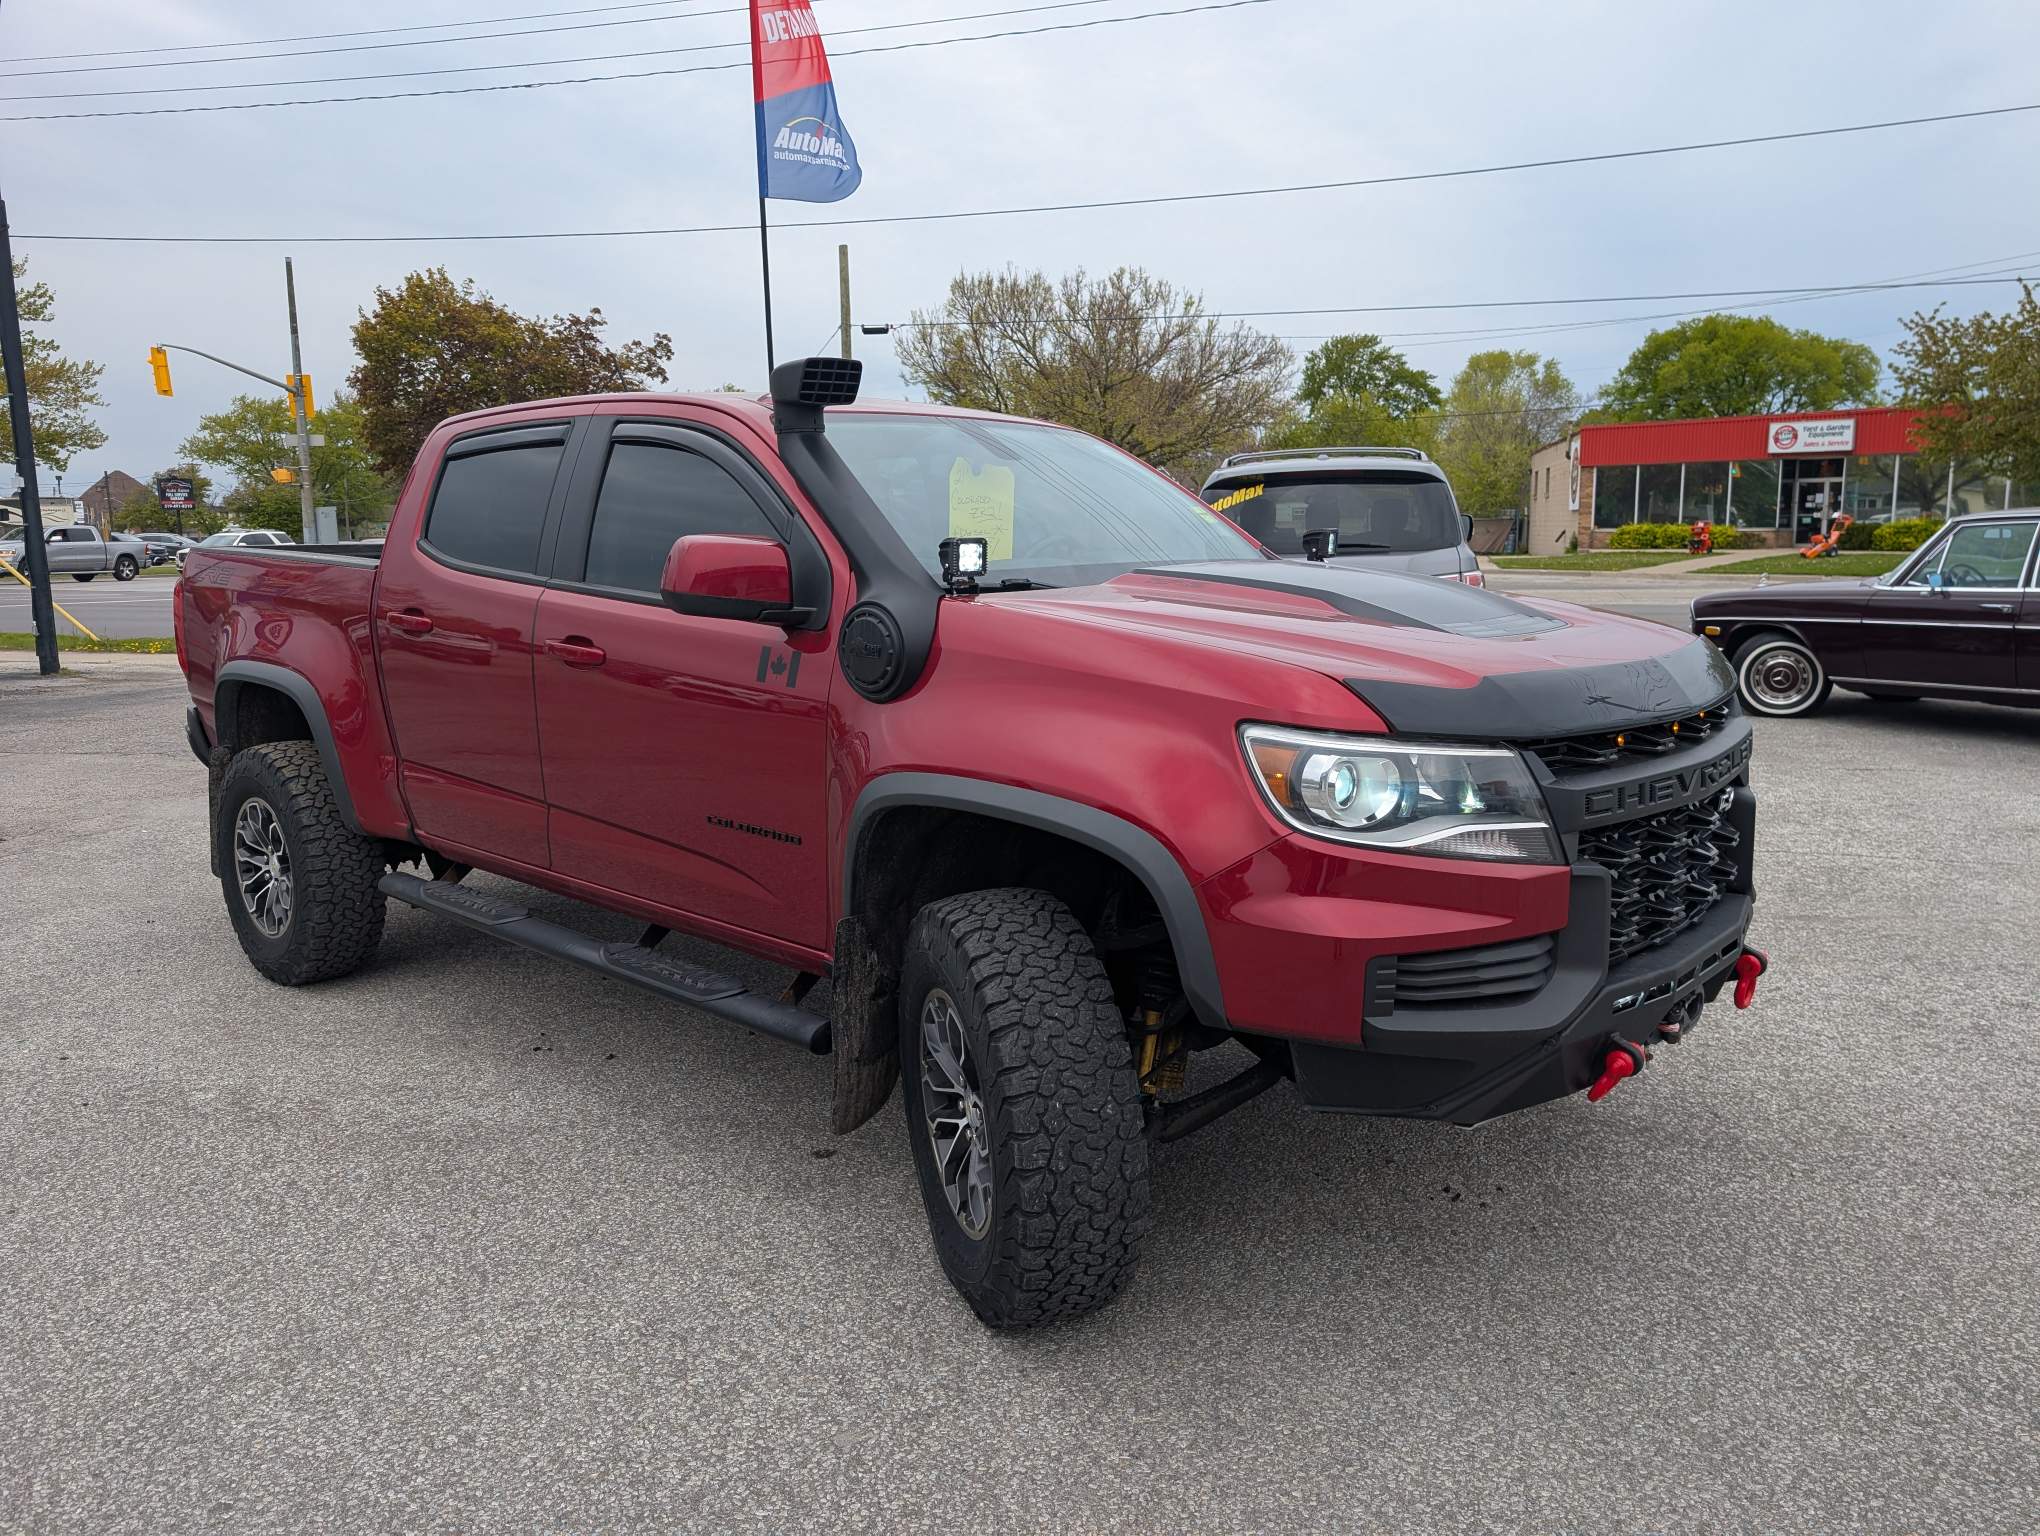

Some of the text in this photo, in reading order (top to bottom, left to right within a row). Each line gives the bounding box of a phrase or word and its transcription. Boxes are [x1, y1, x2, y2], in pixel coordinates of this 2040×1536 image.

[1803, 425, 1820, 433] Yard
[1826, 423, 1851, 432] Garden
[1808, 431, 1844, 439] Equipment
[1210, 483, 1265, 512] utoMax
